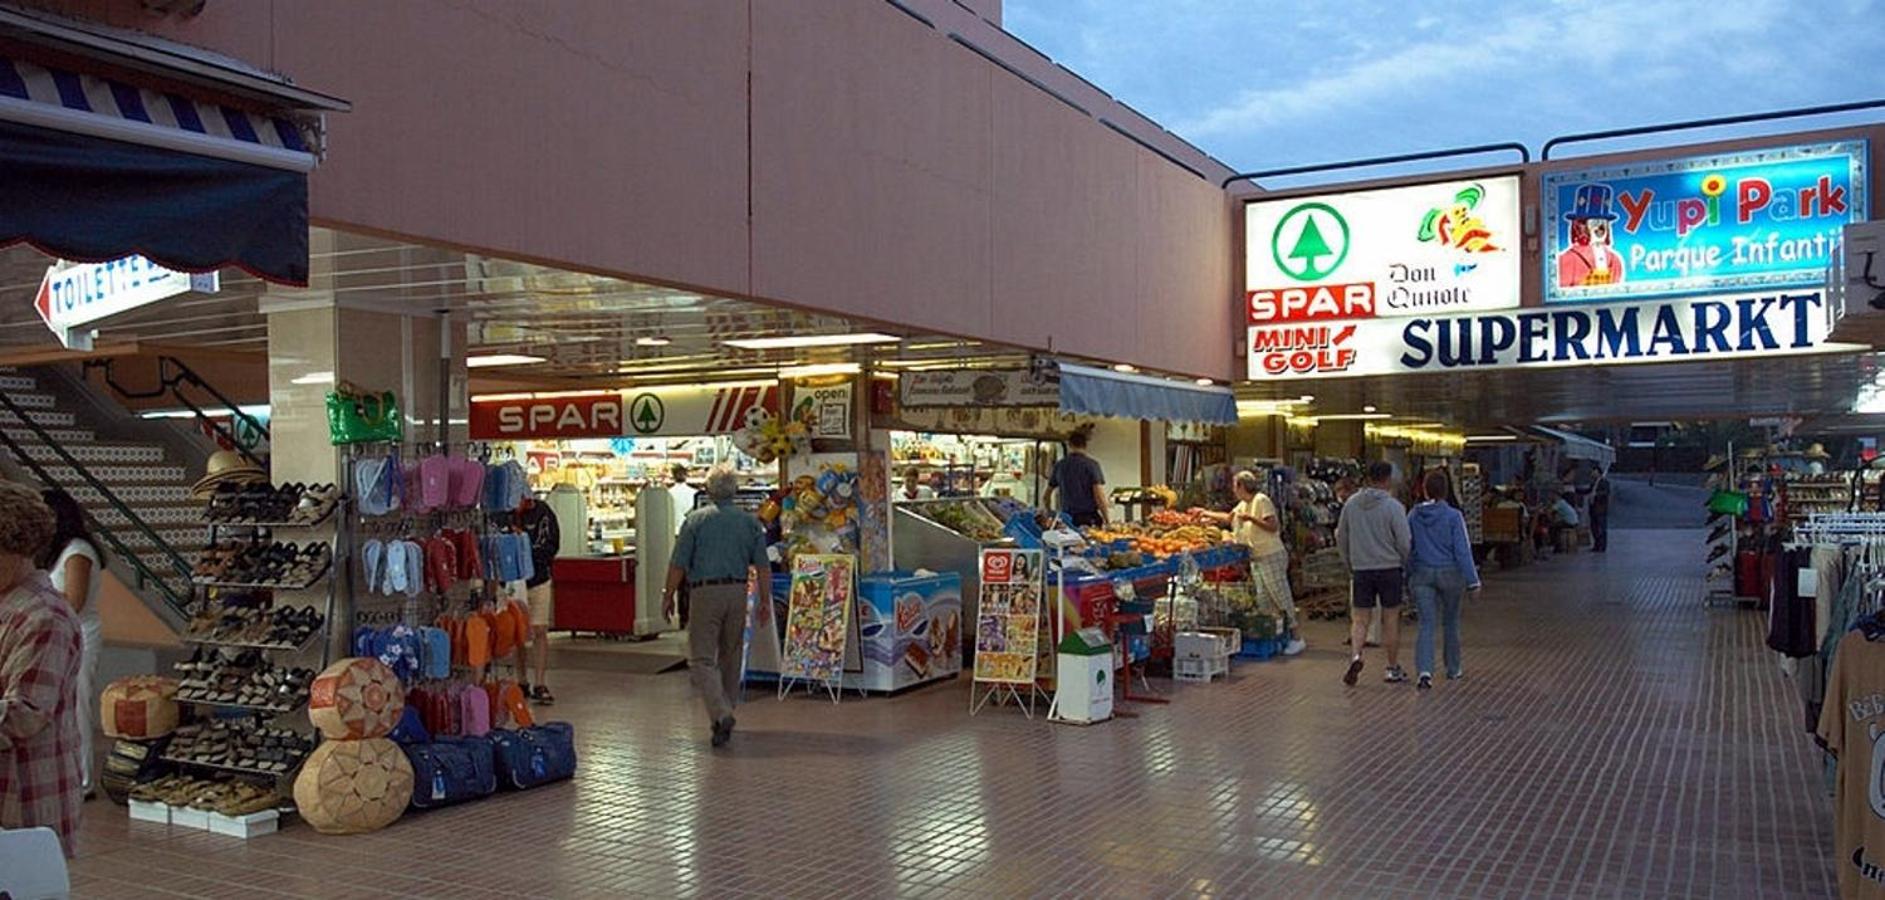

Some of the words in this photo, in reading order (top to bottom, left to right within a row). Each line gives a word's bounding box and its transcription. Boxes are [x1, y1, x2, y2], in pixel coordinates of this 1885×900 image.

[1617, 174, 1727, 237] Yupi
[1737, 175, 1848, 225] Park
[1388, 262, 1436, 283] Don
[1629, 241, 1722, 279] Parque
[1250, 284, 1373, 320] SPAR
[1253, 326, 1330, 352] MINI
[1400, 292, 1821, 369] SUPERMARKT
[1263, 349, 1357, 373] GOLF
[814, 389, 846, 403] open
[499, 402, 620, 432] SPAR
